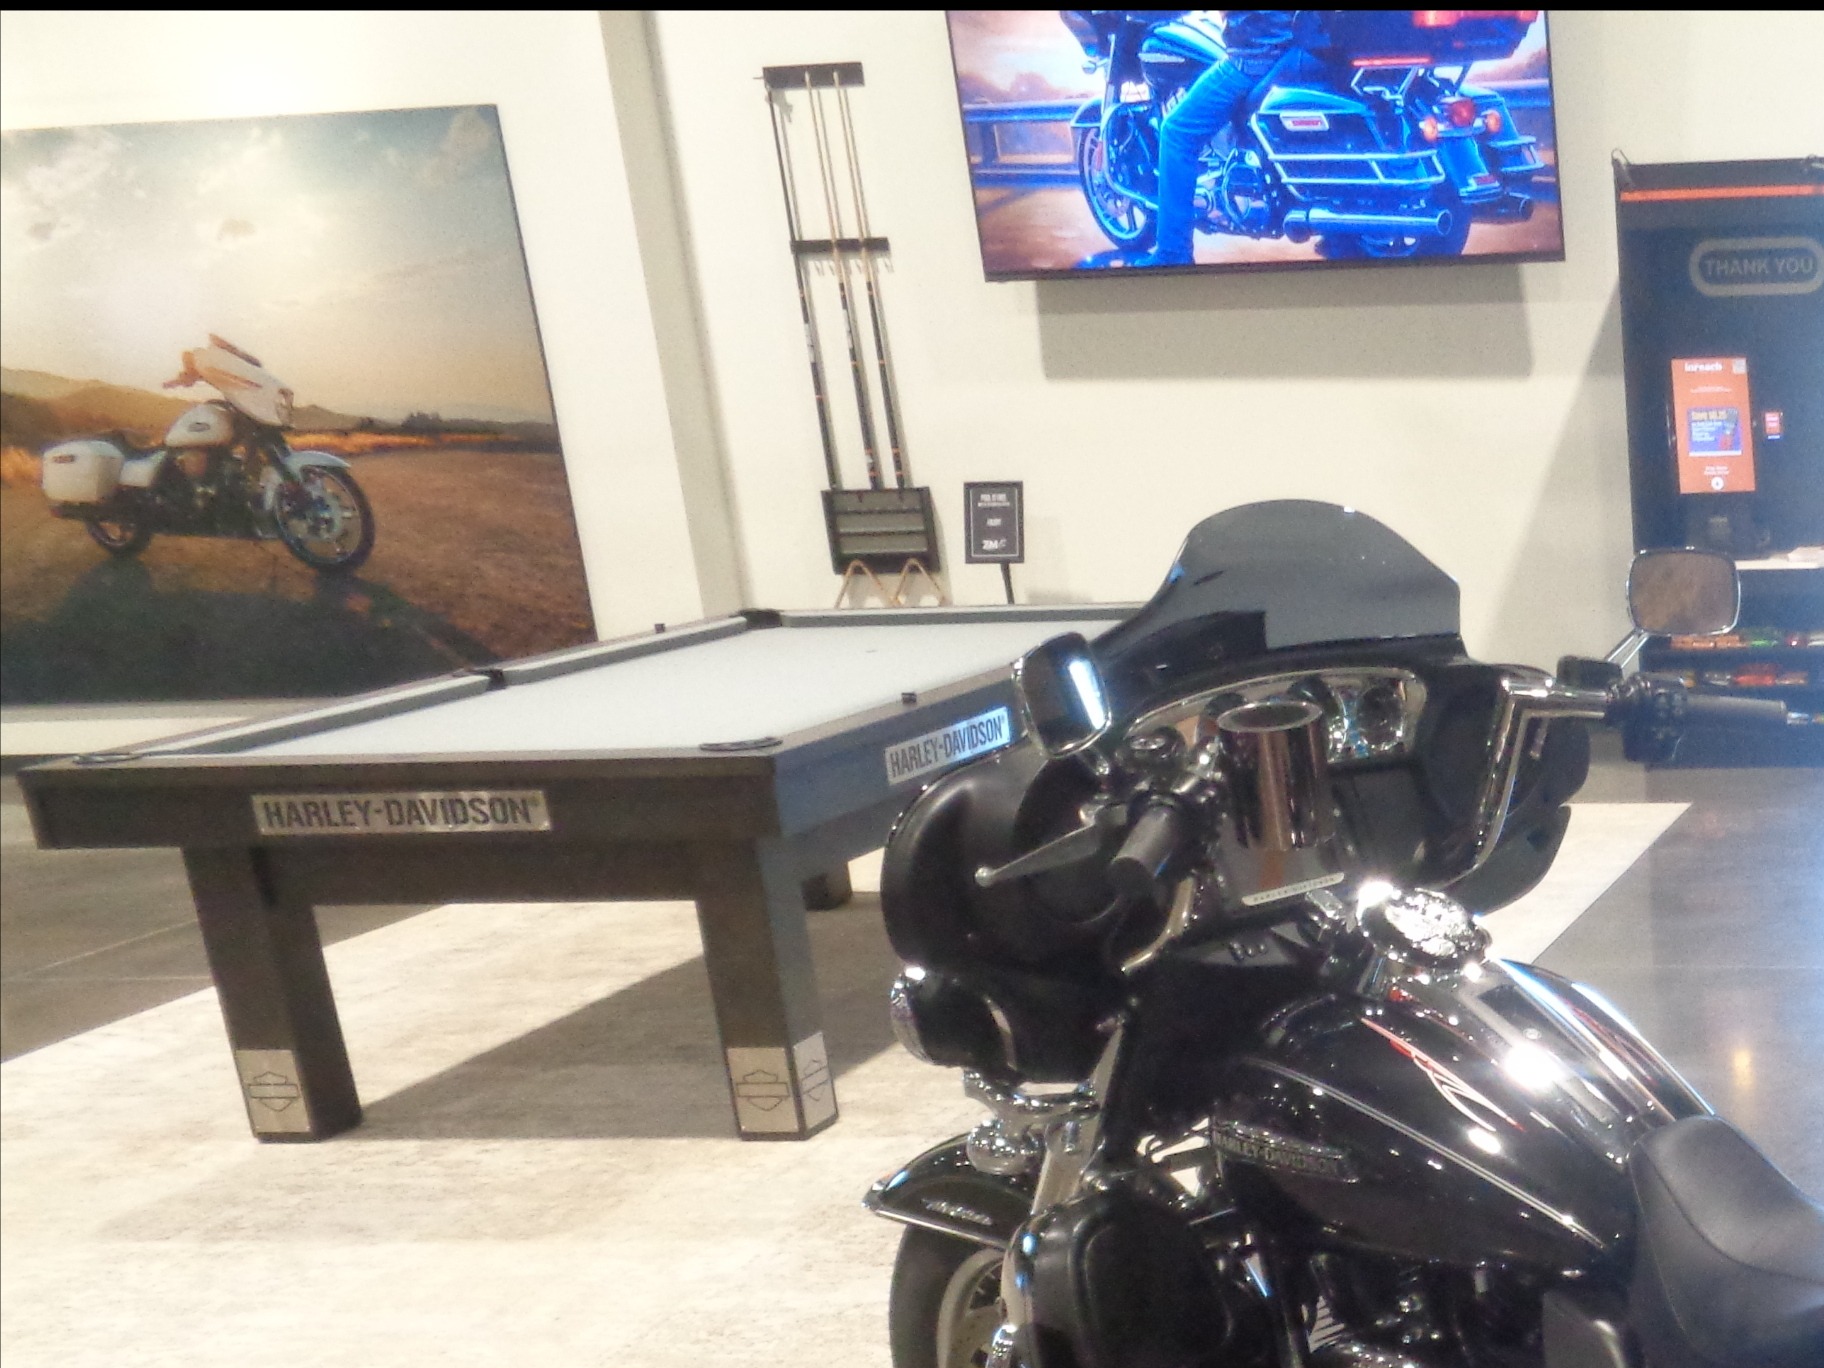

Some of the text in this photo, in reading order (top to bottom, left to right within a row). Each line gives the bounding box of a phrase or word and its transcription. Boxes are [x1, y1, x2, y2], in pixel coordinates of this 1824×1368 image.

[1704, 257, 1814, 275] THANK YOU
[890, 715, 1003, 777] HARLEY-DAVIDSON
[264, 797, 532, 828] HARLEY-DAVIDSON
